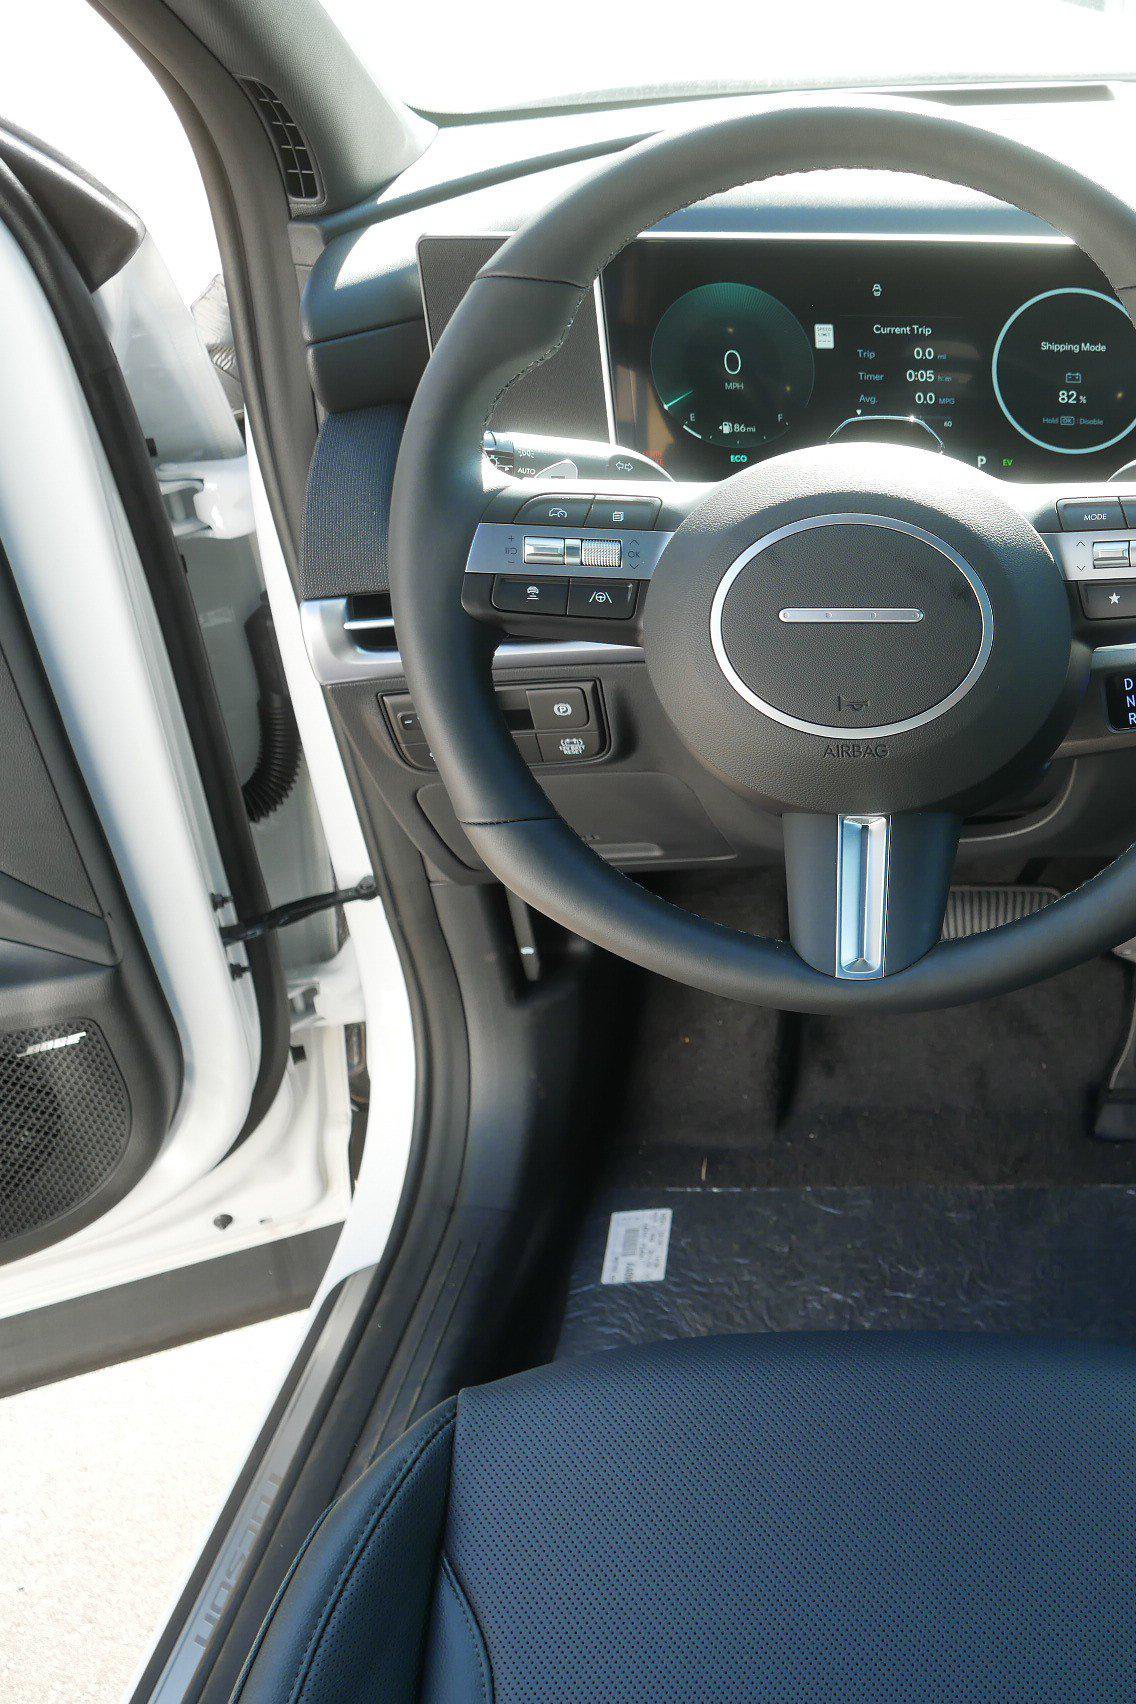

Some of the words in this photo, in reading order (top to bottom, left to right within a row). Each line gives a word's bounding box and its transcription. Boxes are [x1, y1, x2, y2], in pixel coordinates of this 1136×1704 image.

[873, 324, 911, 335] Current
[912, 325, 933, 336] Trip
[856, 348, 877, 360] Trip
[913, 347, 934, 360] 0.0
[1040, 341, 1080, 354] Shipping
[1081, 342, 1107, 352] Mode
[723, 349, 742, 375] 0
[858, 371, 885, 382] Timer
[906, 369, 935, 382] 0:05
[724, 382, 744, 391] MPH
[859, 394, 879, 406] Avg.
[915, 391, 936, 404] 0.0
[1058, 390, 1077, 404] 82
[689, 413, 696, 421] E
[730, 454, 748, 463] ECO
[977, 456, 987, 467] P
[1002, 457, 1014, 467] EV
[517, 467, 536, 475] AUTO
[1083, 513, 1107, 521] MODE
[627, 550, 641, 558] OK
[1124, 677, 1134, 691] D
[1126, 696, 1136, 708] N
[823, 744, 890, 759] AIRBAG
